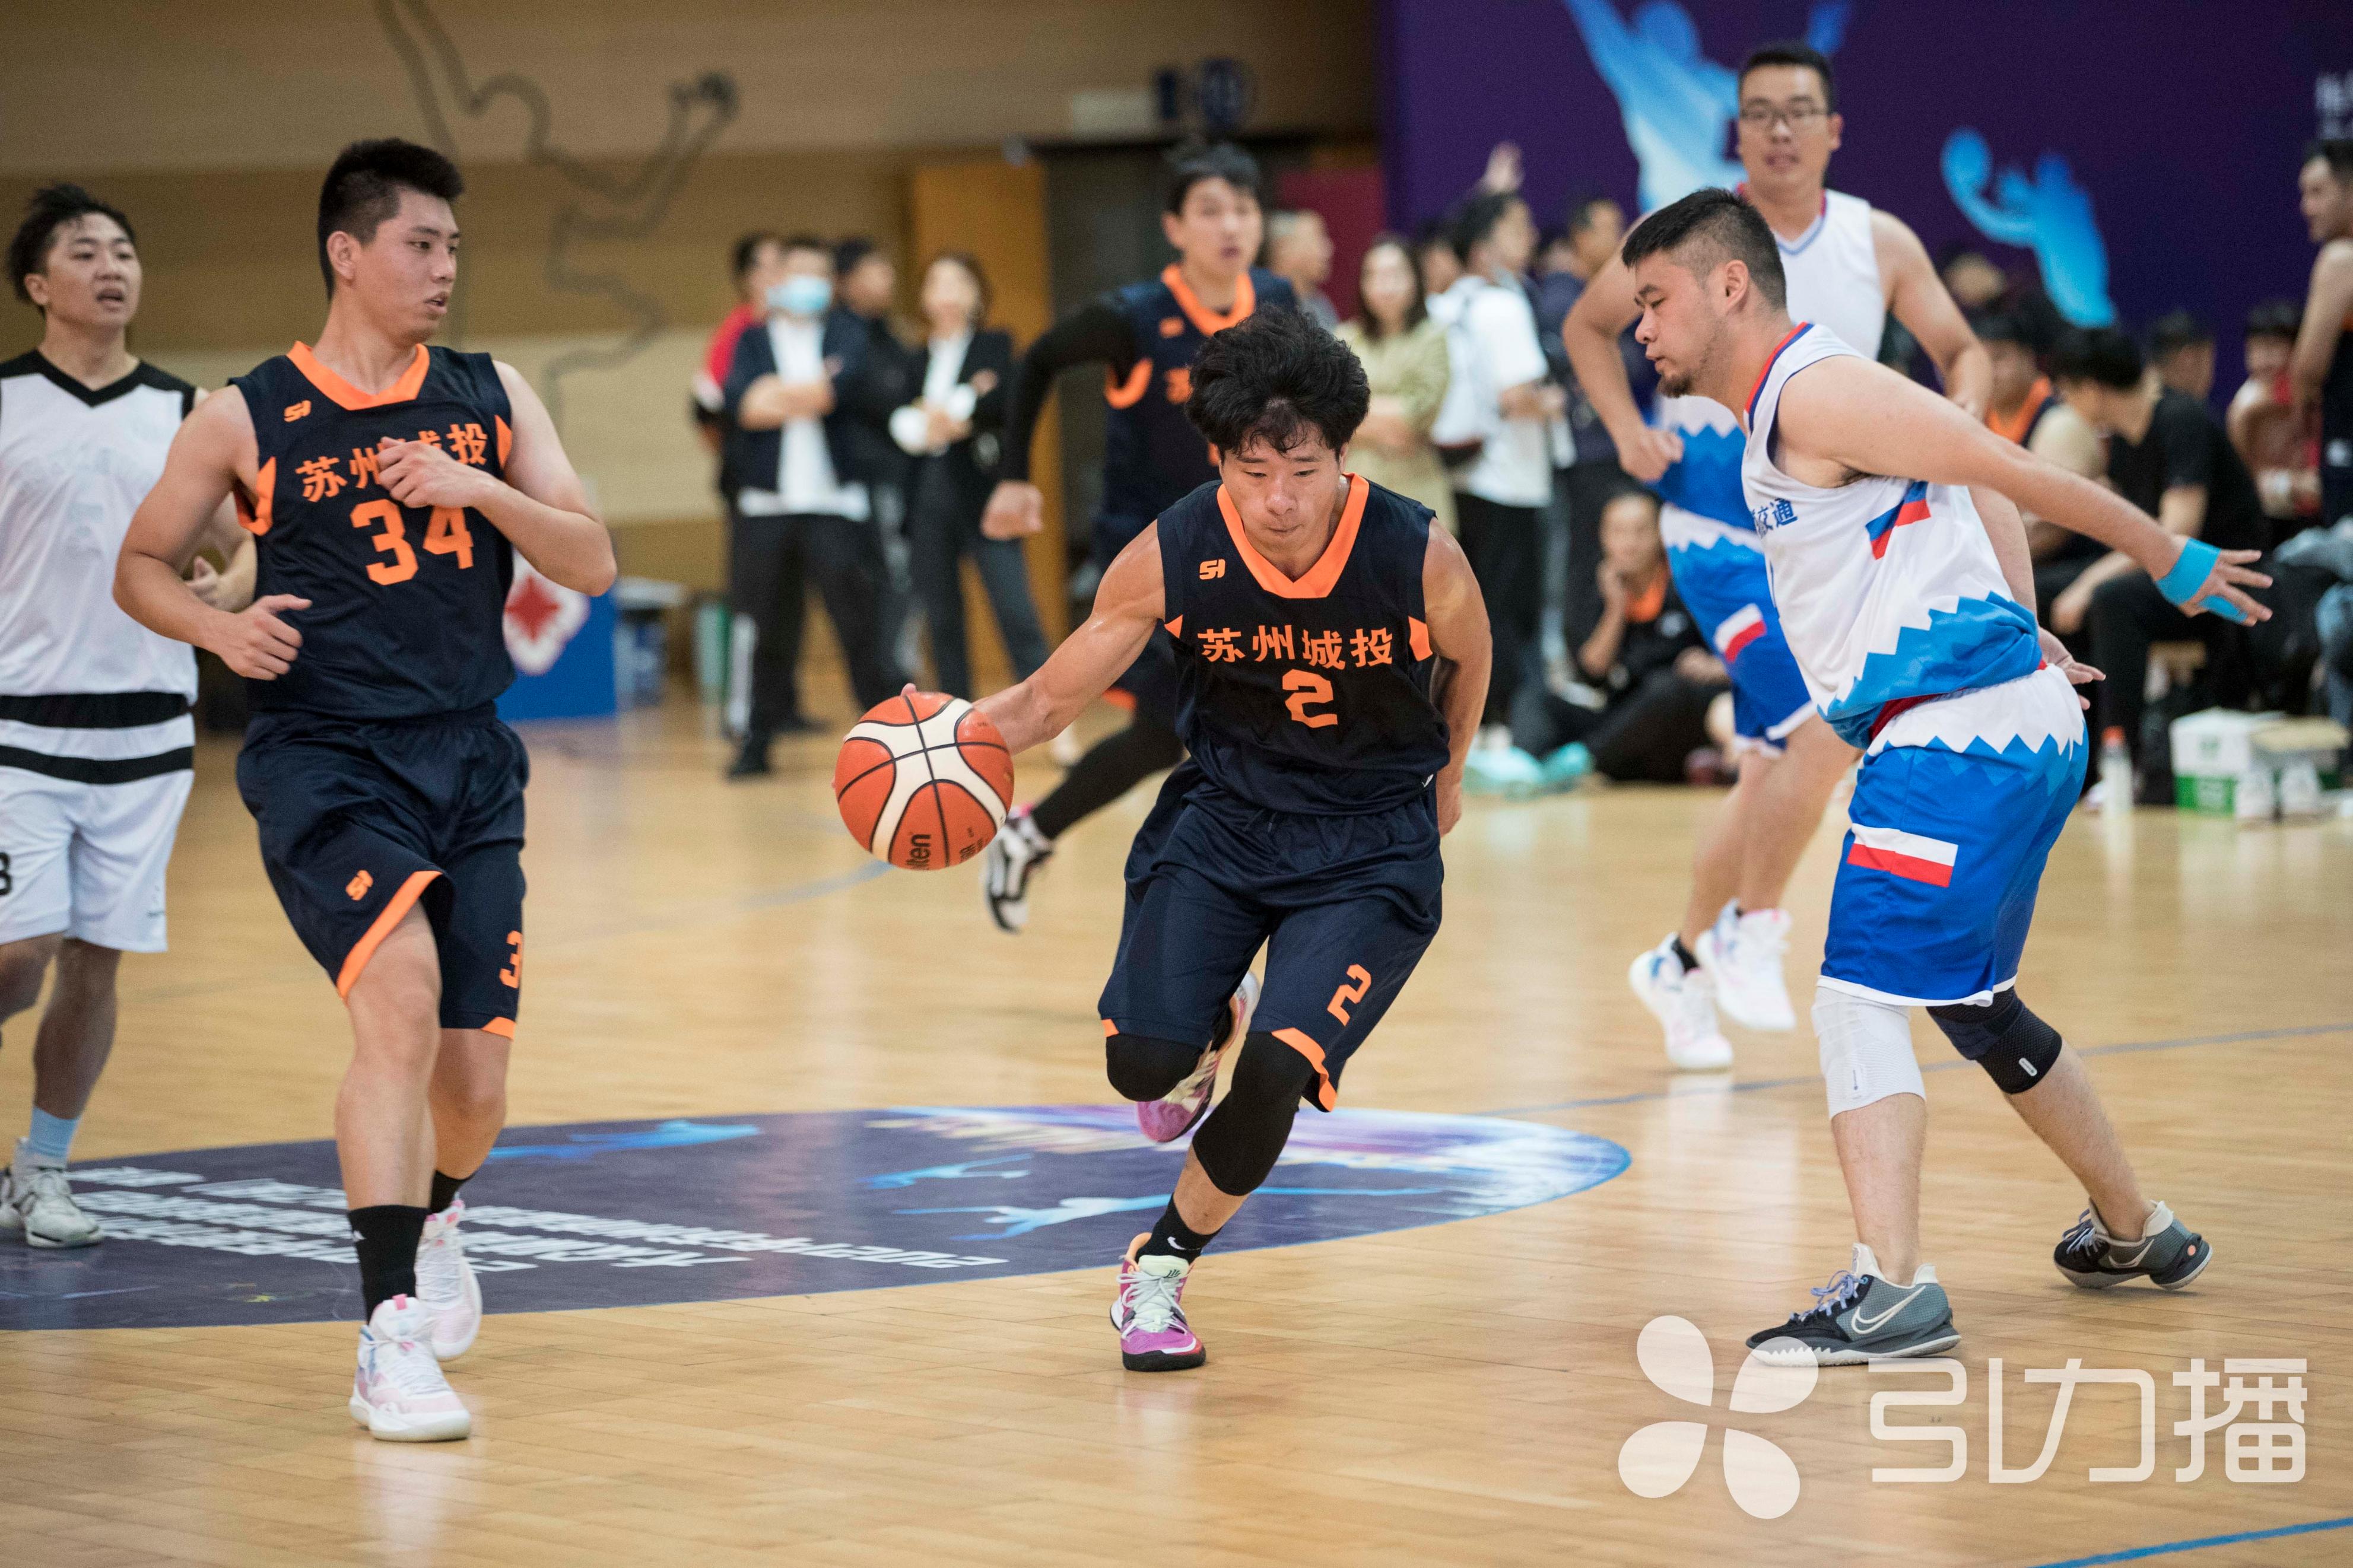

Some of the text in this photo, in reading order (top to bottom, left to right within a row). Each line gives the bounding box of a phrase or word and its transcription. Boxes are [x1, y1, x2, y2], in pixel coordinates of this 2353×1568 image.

[295, 423, 488, 503] 苏州投
[350, 498, 474, 586] 34
[1197, 624, 1393, 670] 苏州城投
[1282, 669, 1338, 728] 2
[499, 930, 523, 989] 3
[1327, 964, 1371, 1026] 2
